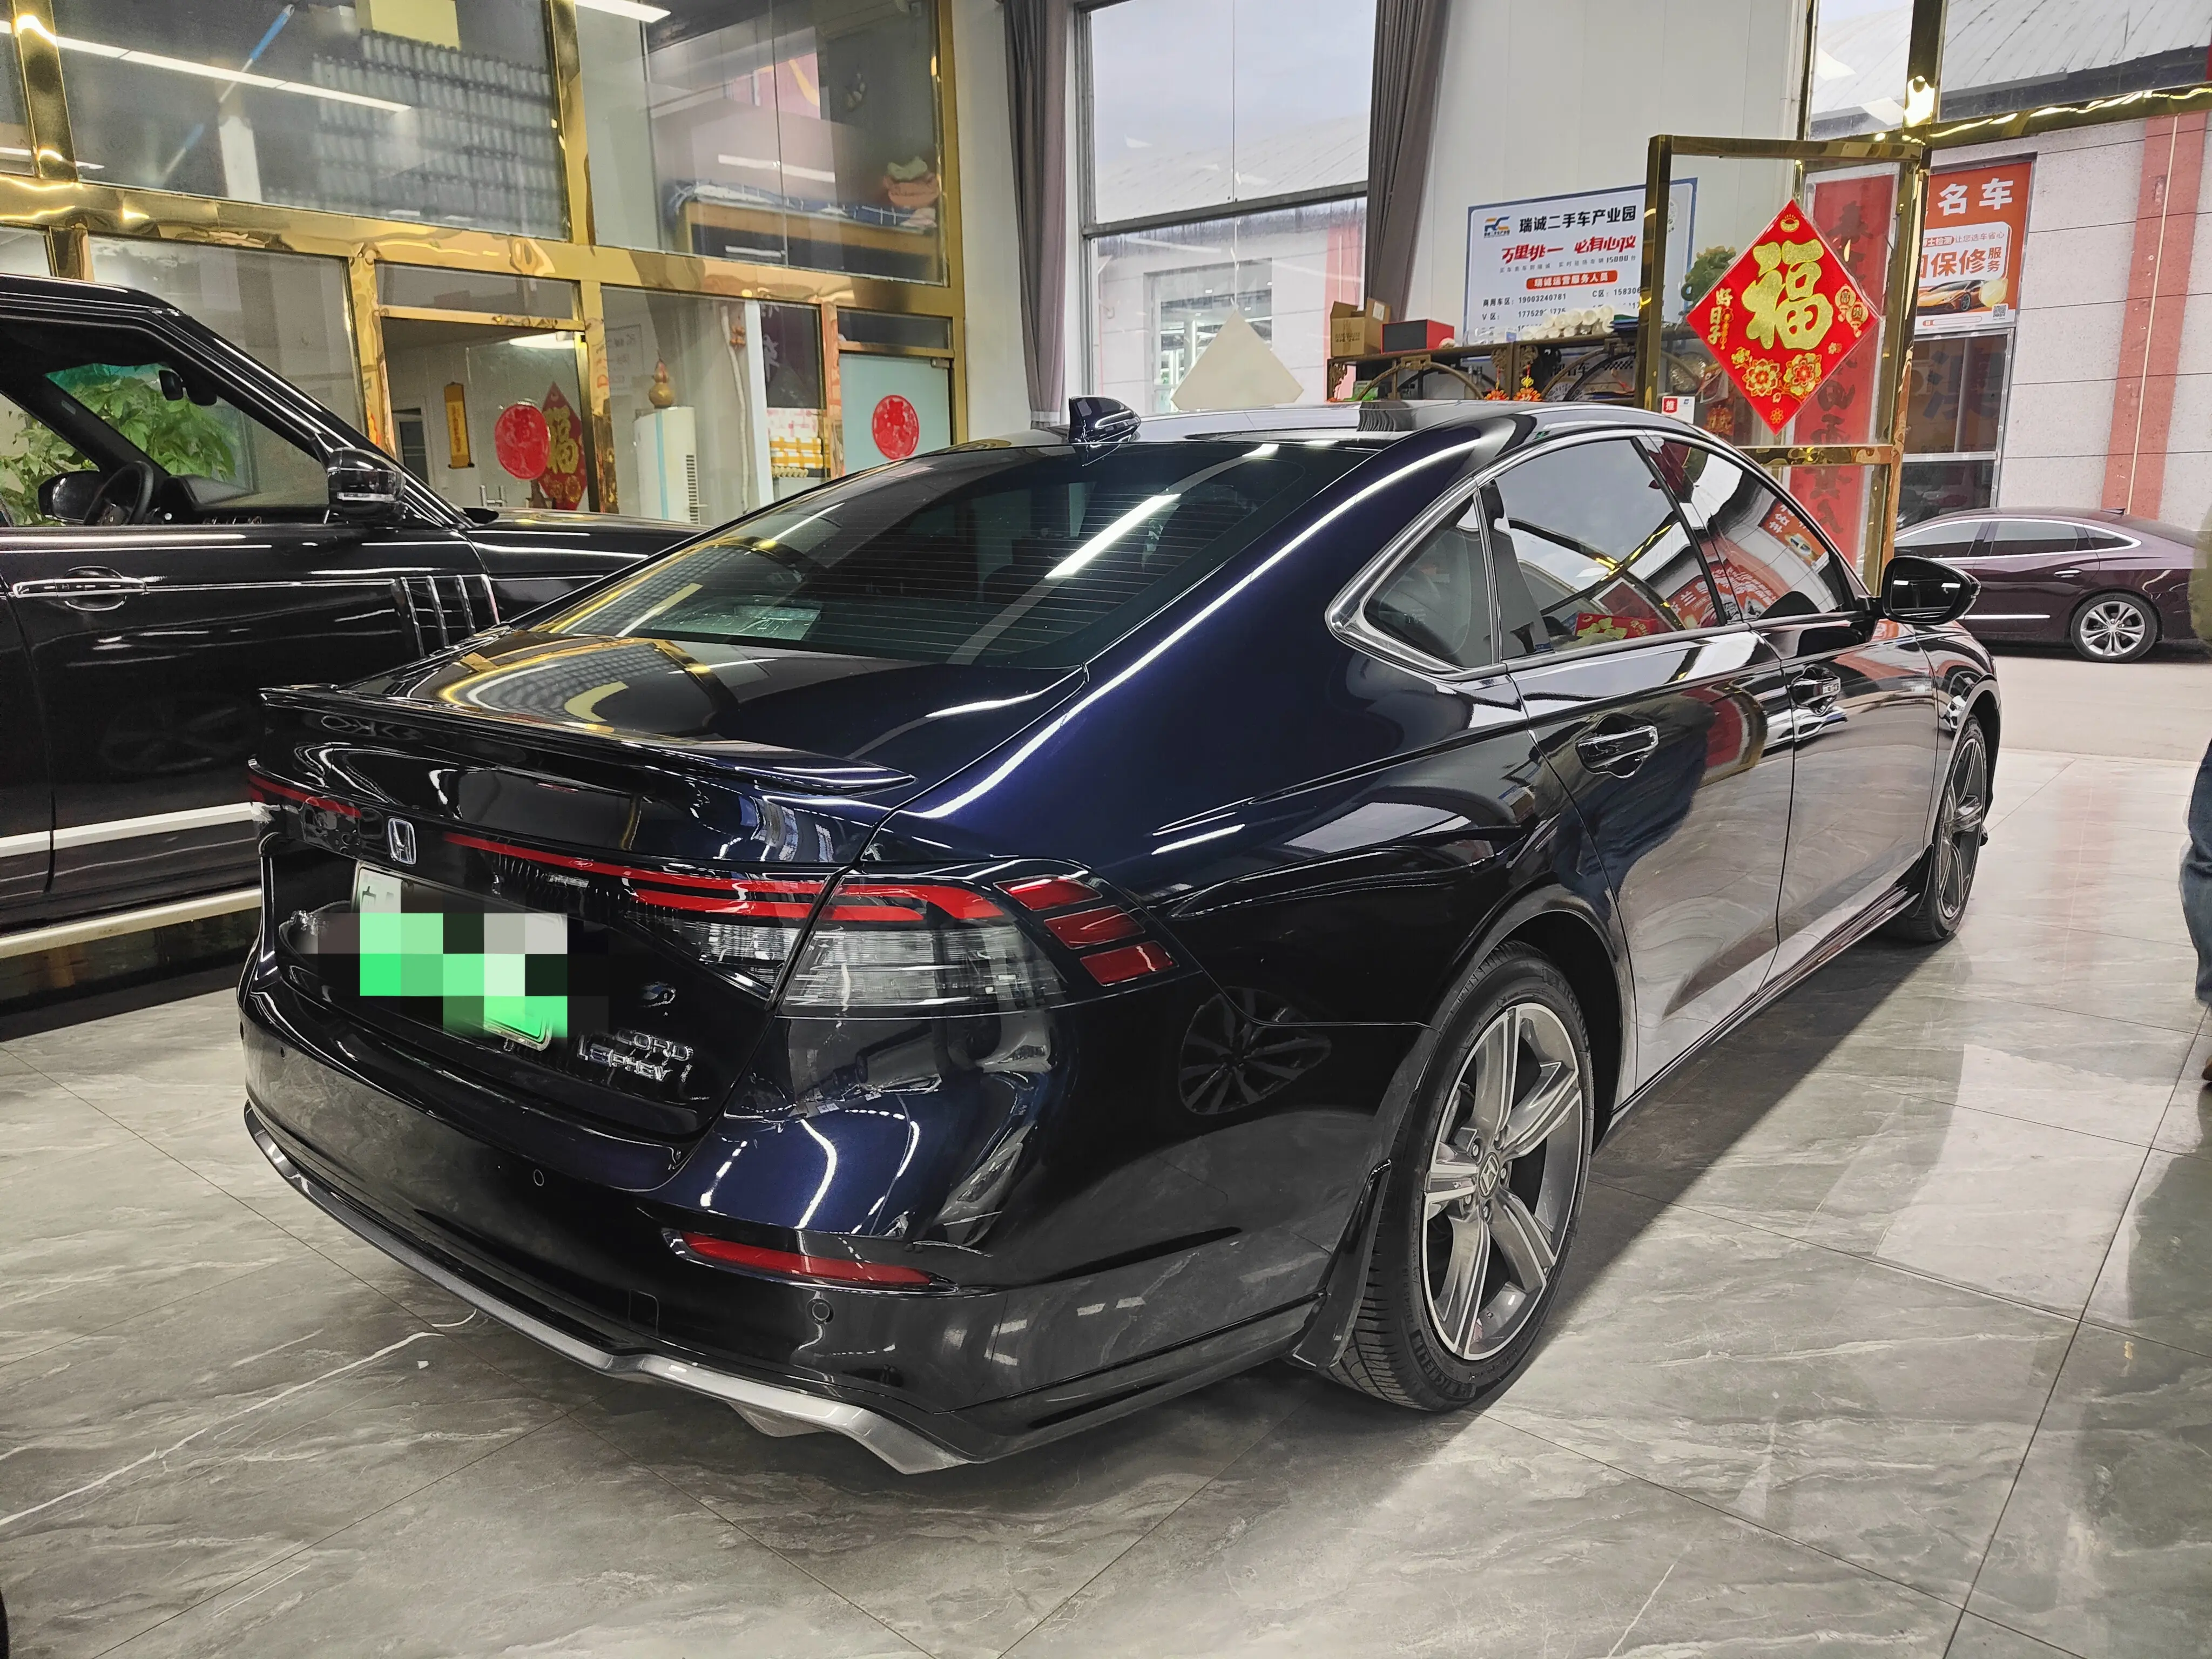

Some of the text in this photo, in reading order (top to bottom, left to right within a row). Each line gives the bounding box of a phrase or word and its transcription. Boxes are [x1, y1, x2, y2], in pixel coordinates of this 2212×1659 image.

[1926, 178, 2014, 216] 名车
[1519, 205, 1637, 234] 瑞诚二手车产业园
[1501, 235, 1637, 265] 万里挑一 必有心仪
[1955, 231, 2005, 243] 让您选车省心
[1987, 247, 2002, 273] 服务
[1534, 273, 1609, 287] 瑞诚运营服务人员
[1742, 239, 1833, 349] 福
[1518, 293, 1566, 304] 19003240781
[1708, 287, 1734, 345] 好日子
